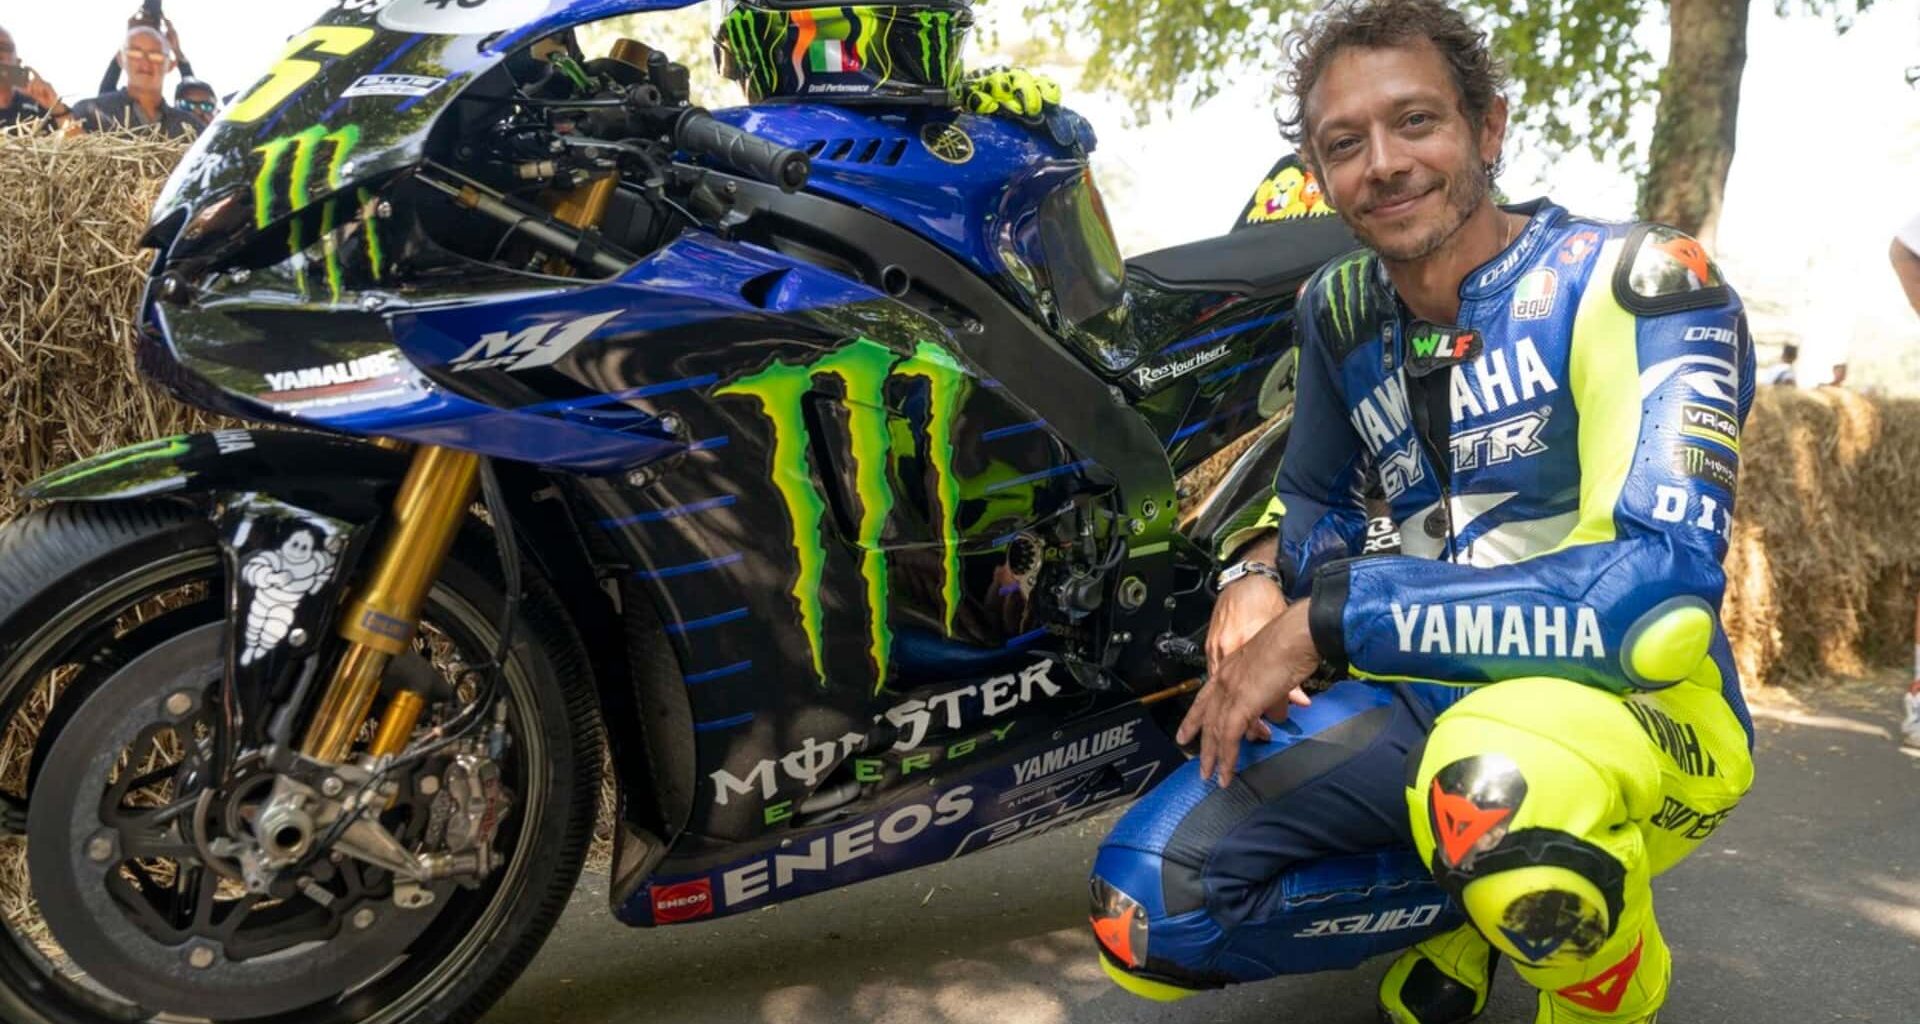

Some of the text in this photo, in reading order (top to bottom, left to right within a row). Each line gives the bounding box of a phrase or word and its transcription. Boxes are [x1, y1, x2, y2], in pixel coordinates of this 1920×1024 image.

[263, 347, 401, 392] YAMALUBE
[1412, 333, 1474, 358] WLF
[1390, 602, 1605, 657] YAMAHA
[763, 721, 1016, 826] EERGY
[1012, 718, 1143, 785] YAMALUBE
[723, 785, 974, 907] ENEOS
